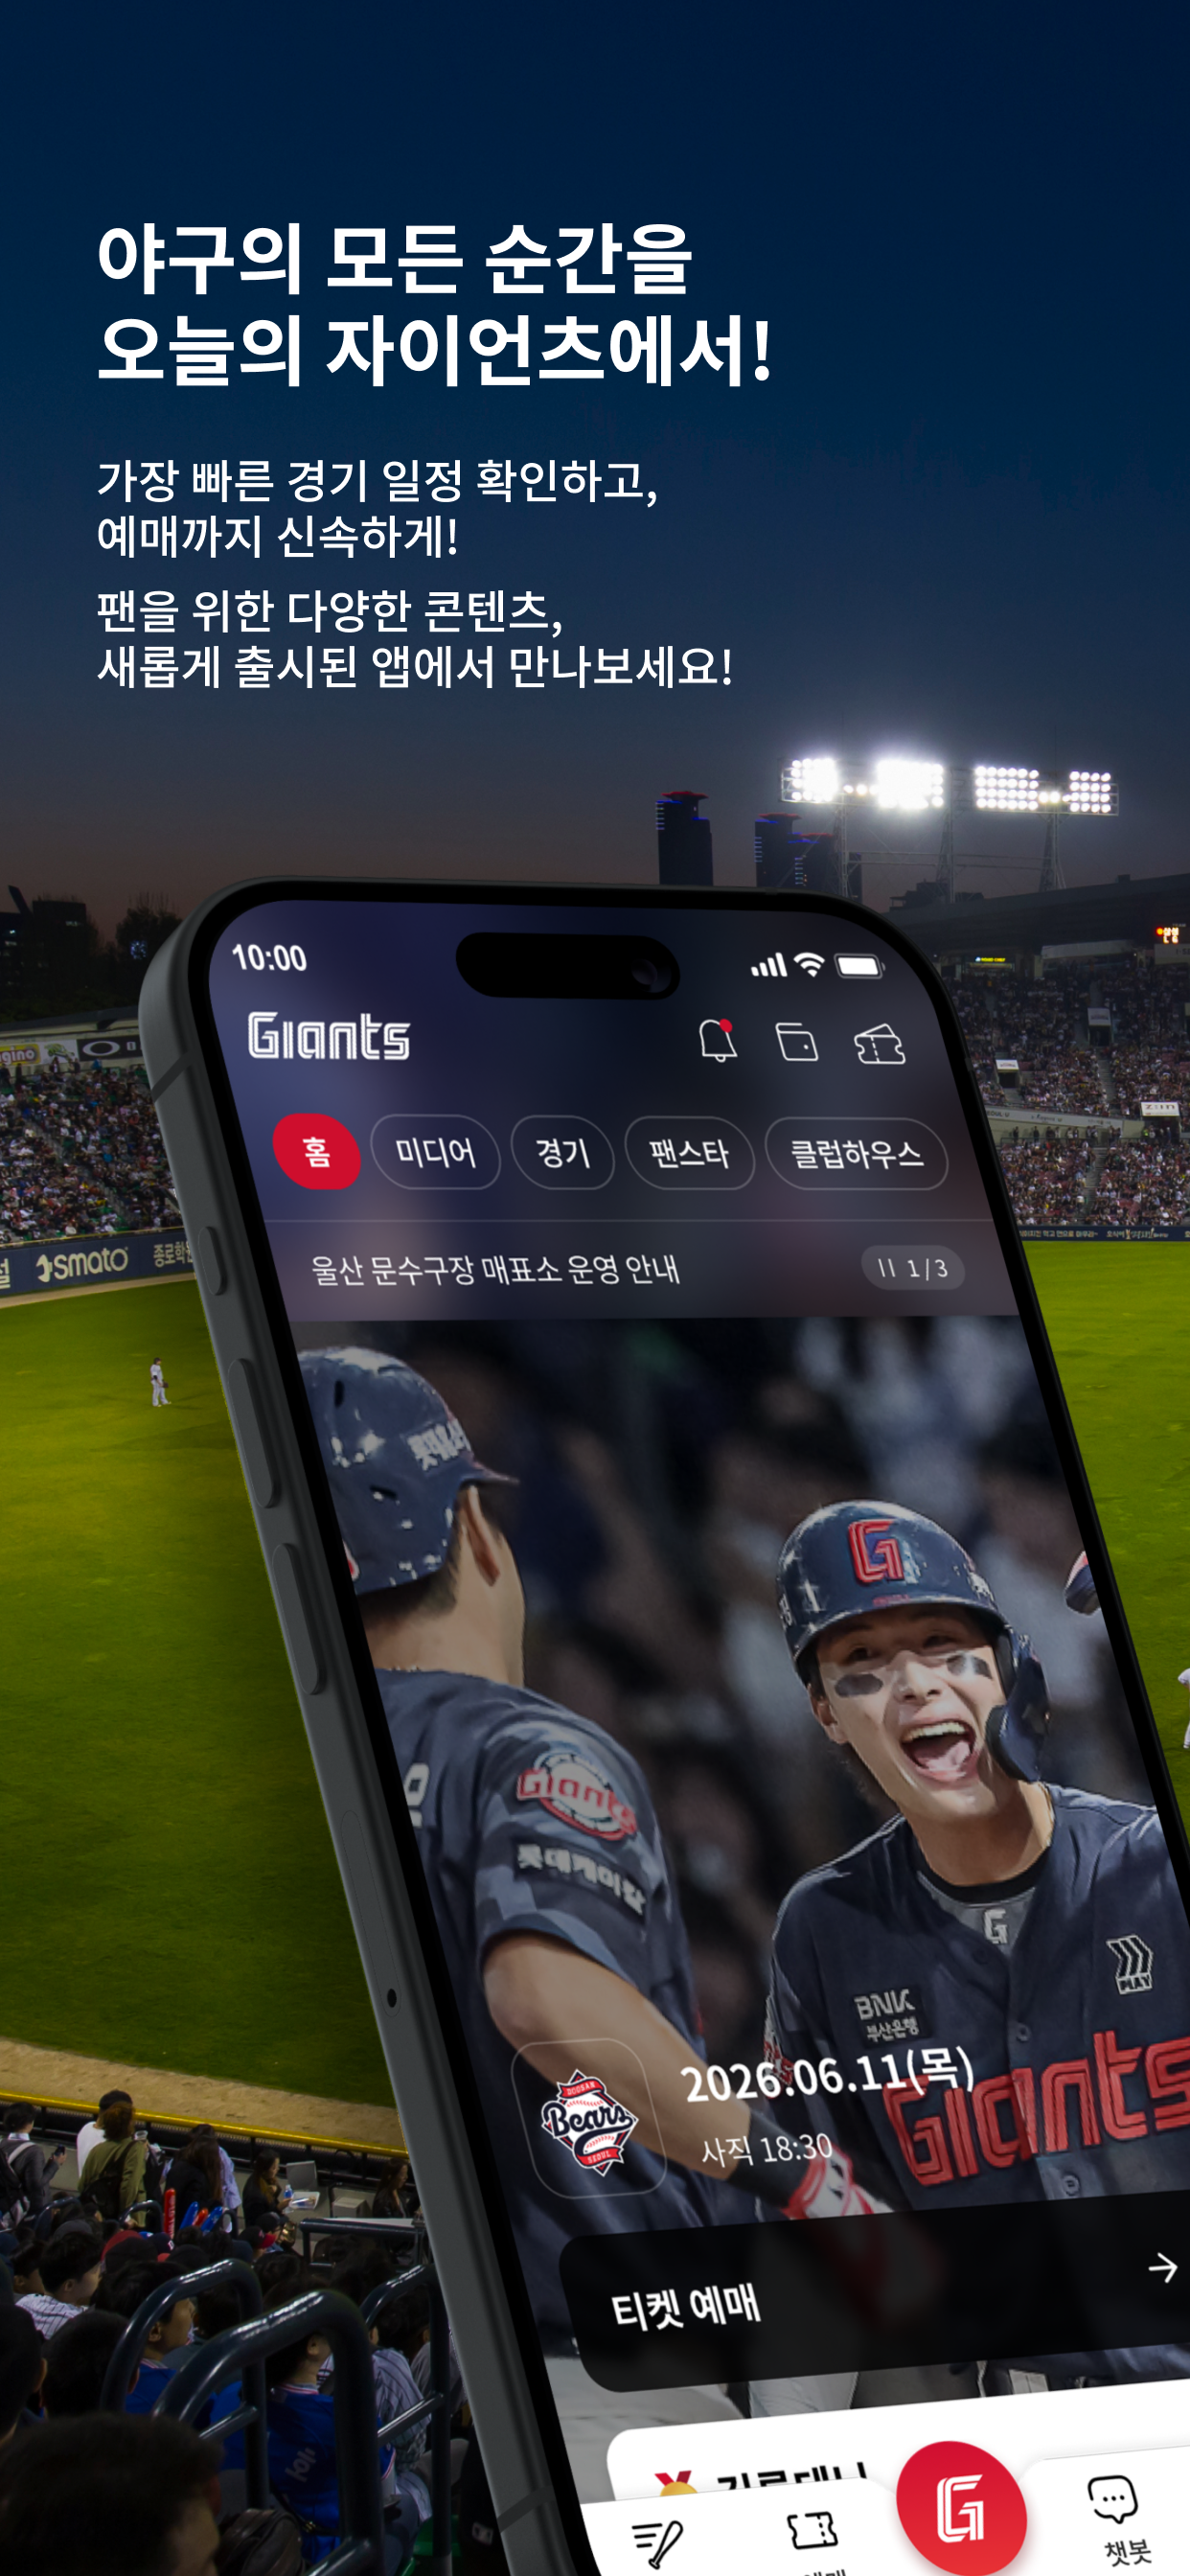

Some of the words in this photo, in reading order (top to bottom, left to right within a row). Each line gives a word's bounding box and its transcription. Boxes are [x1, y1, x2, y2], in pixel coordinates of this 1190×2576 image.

[232, 943, 308, 972] 10:00
[247, 1011, 411, 1061] Giants
[0, 1046, 35, 1066] gino
[302, 1136, 331, 1168] 홈
[396, 1138, 476, 1168] 미디어
[536, 1138, 590, 1168] 경기
[649, 1138, 729, 1169] 팬스타
[791, 1139, 925, 1170] 클럽하우스
[54, 1248, 128, 1280] smato
[311, 1255, 365, 1286] 울산
[371, 1254, 474, 1286] 문수구장
[481, 1254, 563, 1285] 매표소
[568, 1254, 620, 1285] 운영
[626, 1254, 680, 1284] 안내
[854, 1989, 916, 2021] BNK
[866, 2016, 920, 2042] 부산은행
[566, 2082, 597, 2096] DOOSAN
[680, 2046, 974, 2103] 2026.06.11(목)
[541, 2101, 634, 2141] Bears
[586, 2150, 612, 2164] SEOUL
[701, 2135, 755, 2169] 사직
[760, 2132, 834, 2163] 18:30
[611, 2289, 685, 2332] 티켓
[689, 2281, 762, 2326] 예매
[1105, 2539, 1153, 2568] 챗봇
